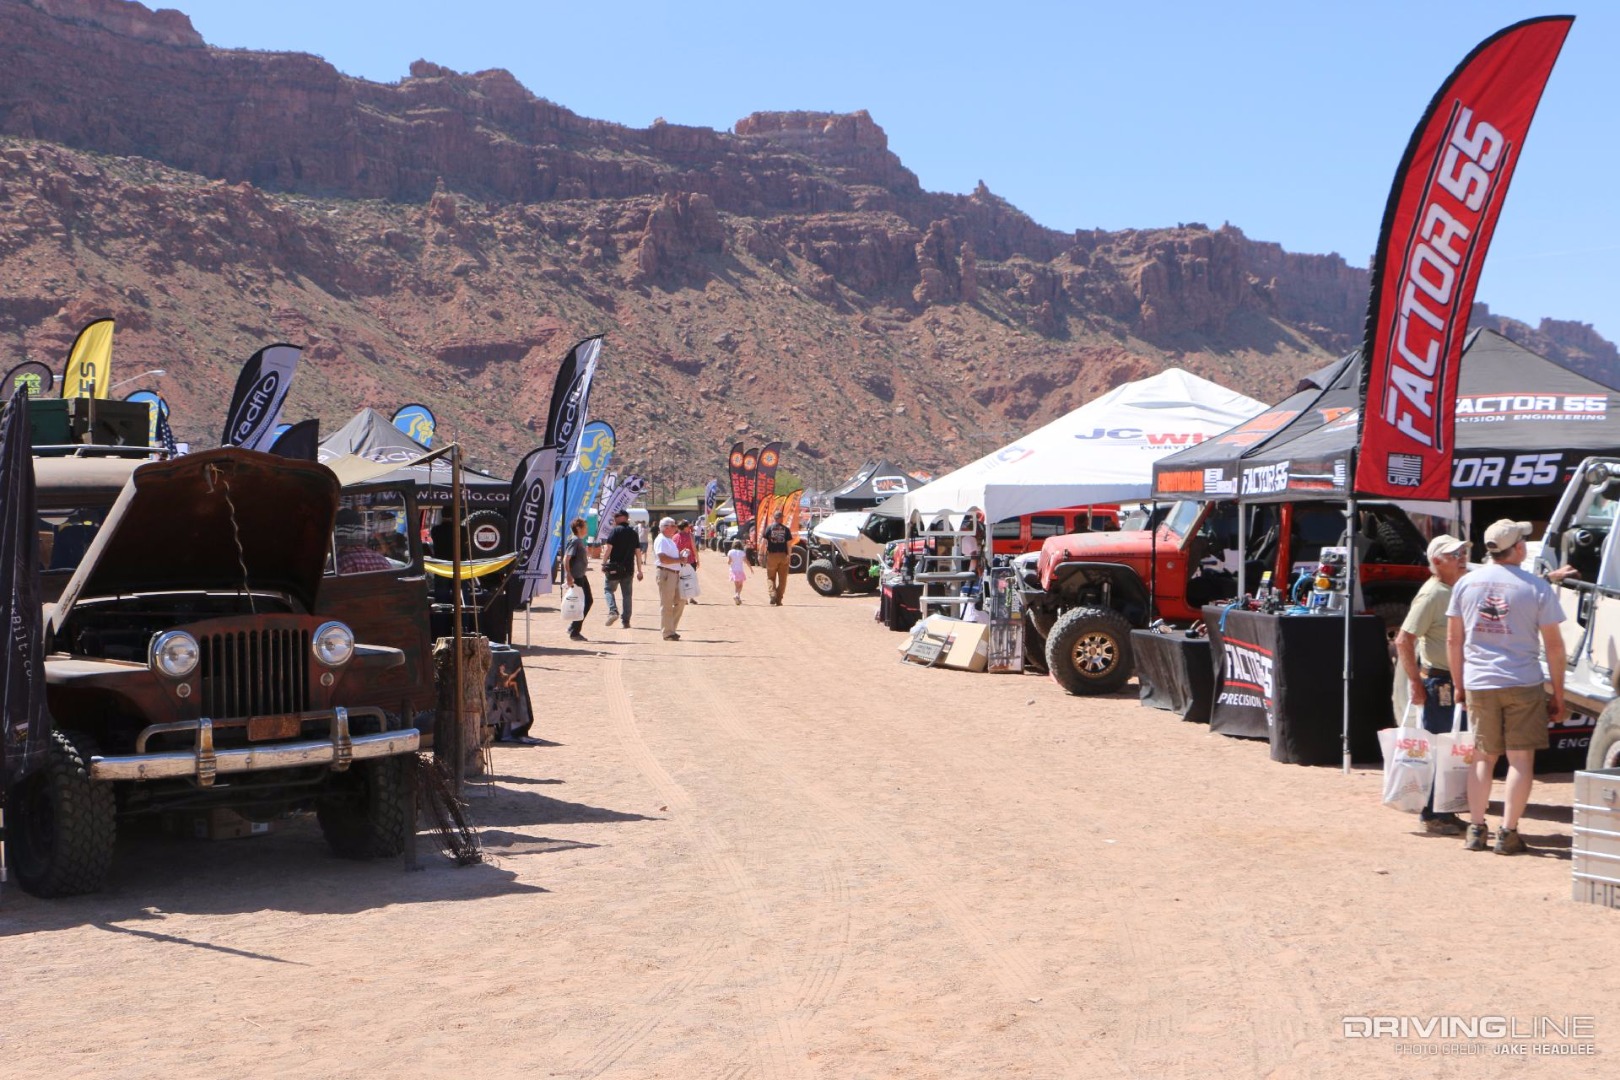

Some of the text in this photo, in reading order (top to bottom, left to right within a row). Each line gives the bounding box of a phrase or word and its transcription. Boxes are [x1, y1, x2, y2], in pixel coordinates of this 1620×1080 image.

[1386, 202, 1470, 447] FACTOR
[1437, 107, 1504, 211] 55
[234, 376, 276, 442] radflo
[1455, 396, 1608, 413] ACTOR 55
[1387, 475, 1420, 487] USA
[1508, 453, 1563, 486] 55
[1217, 692, 1262, 708] PRECISION
